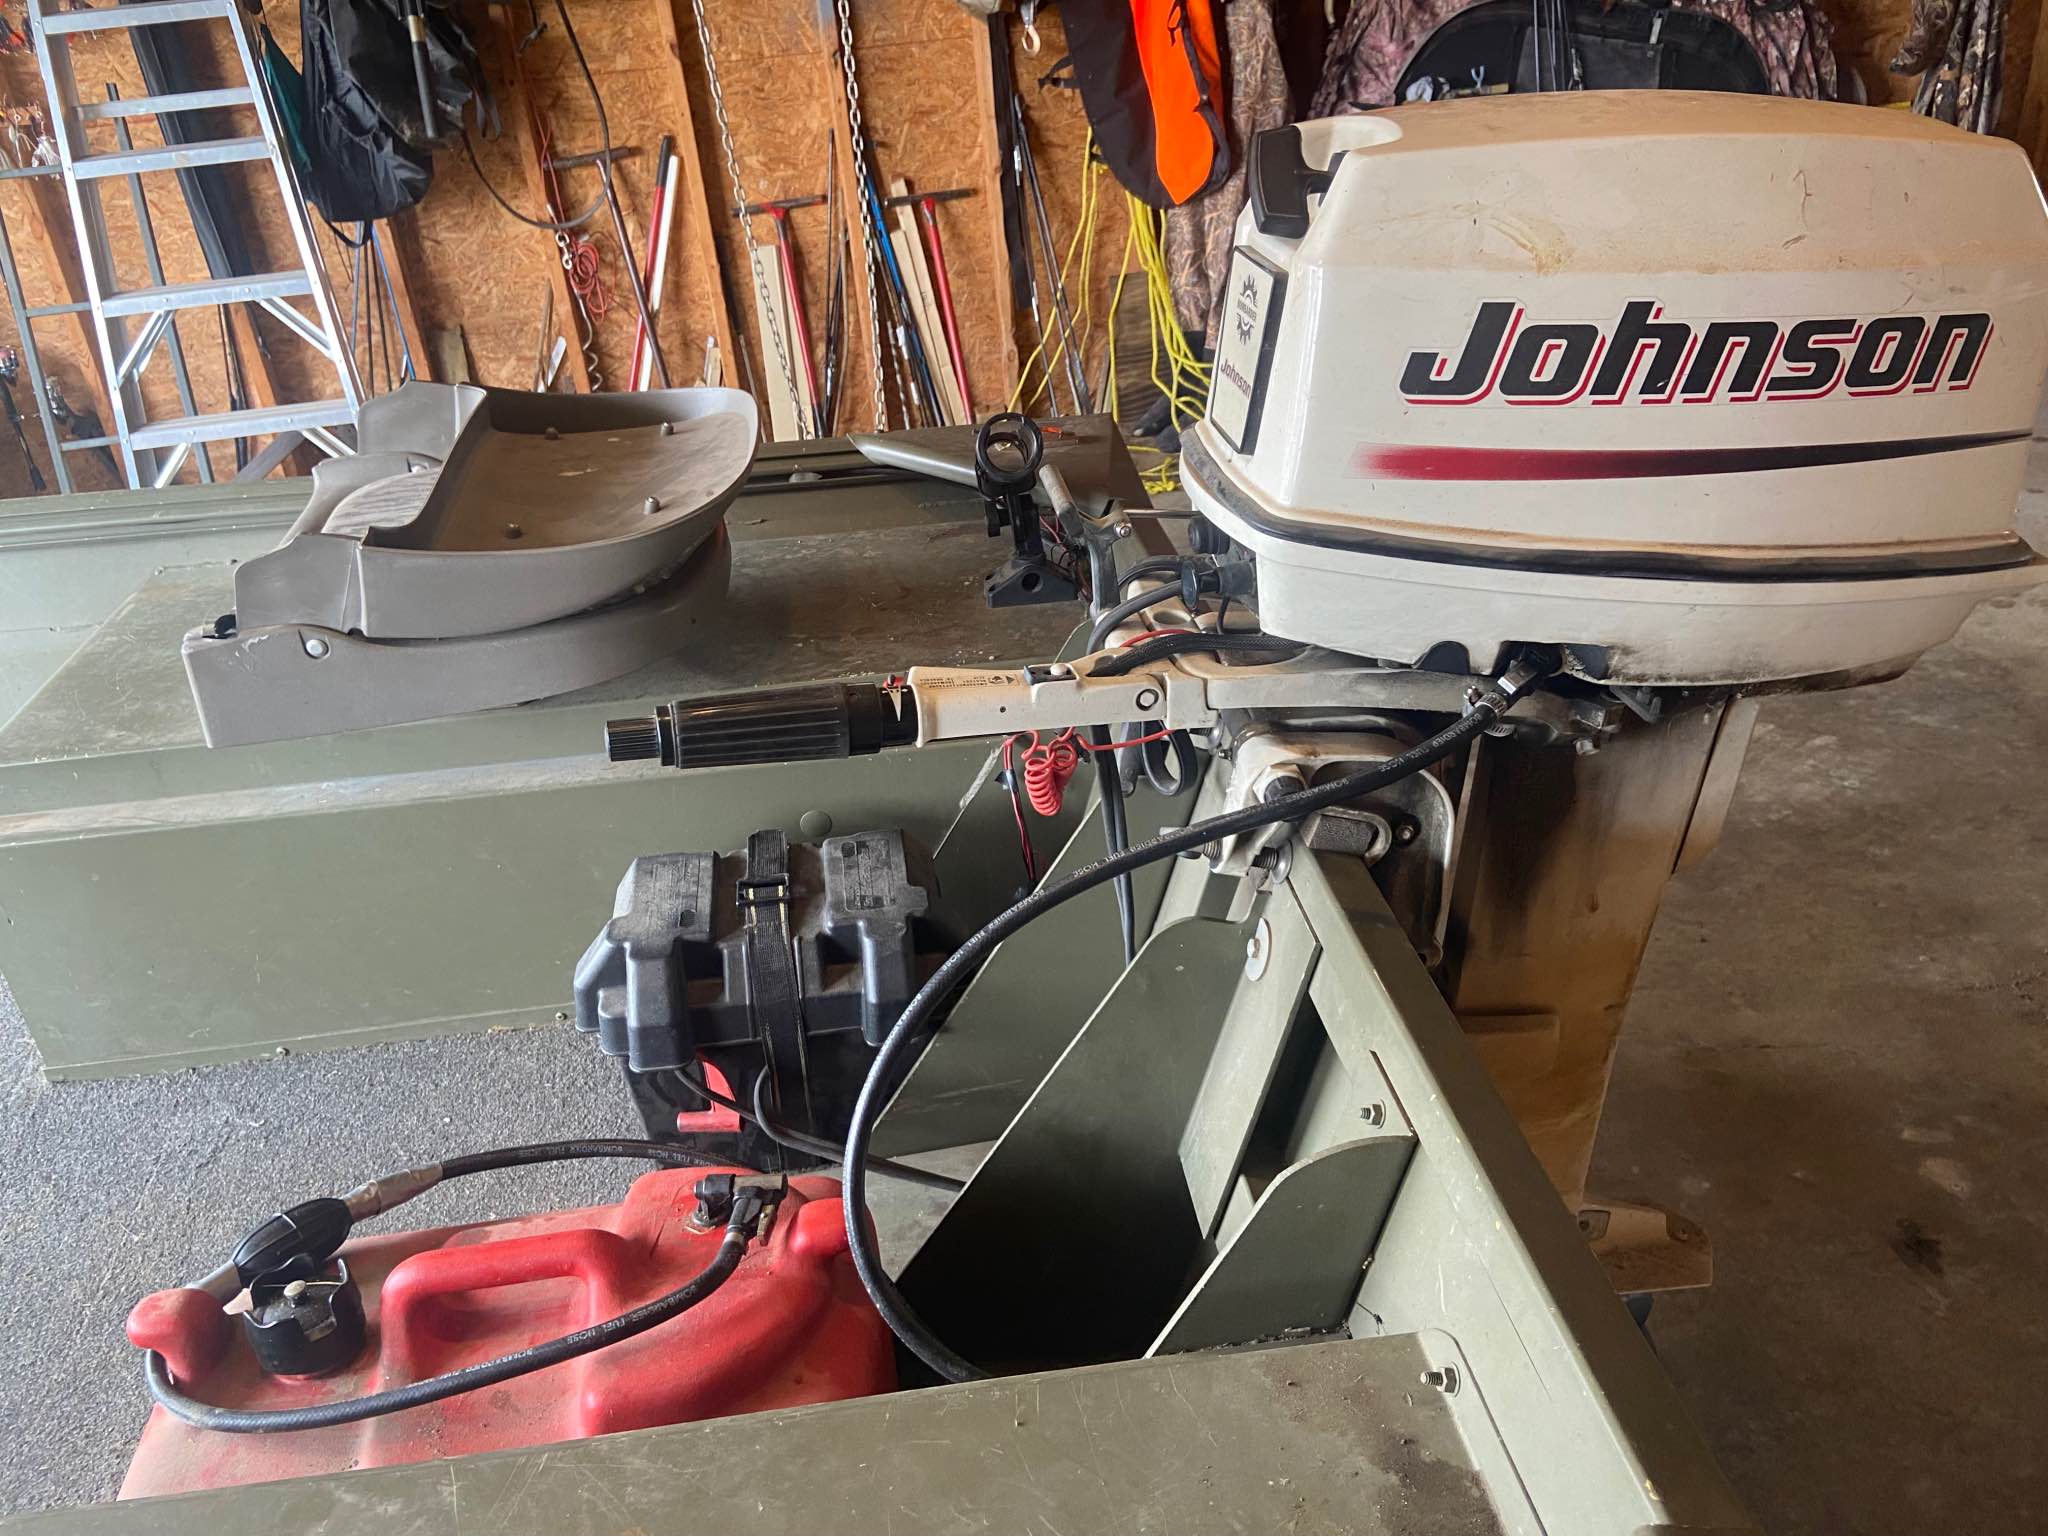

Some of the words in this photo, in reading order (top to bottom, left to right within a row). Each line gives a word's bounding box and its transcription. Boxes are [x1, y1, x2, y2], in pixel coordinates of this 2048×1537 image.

[1237, 297, 1257, 323] BOMBARDIER
[1399, 298, 1995, 406] Johnson
[1221, 358, 1252, 401] Johnson
[1431, 712, 1482, 748] BOMBARDIER
[1406, 745, 1430, 760] FUEL
[1377, 756, 1405, 773] HOSE
[1105, 848, 1126, 863] FUEL
[1072, 861, 1100, 878] HOSE
[988, 889, 1045, 928] BOMBARDIER
[966, 929, 985, 947] FUEL
[941, 949, 964, 971] HOSE
[672, 1152, 690, 1163] FUEL
[629, 1285, 697, 1322] BOMBARDIER
[602, 1317, 626, 1333] FUEL
[567, 1327, 596, 1345] HOSE
